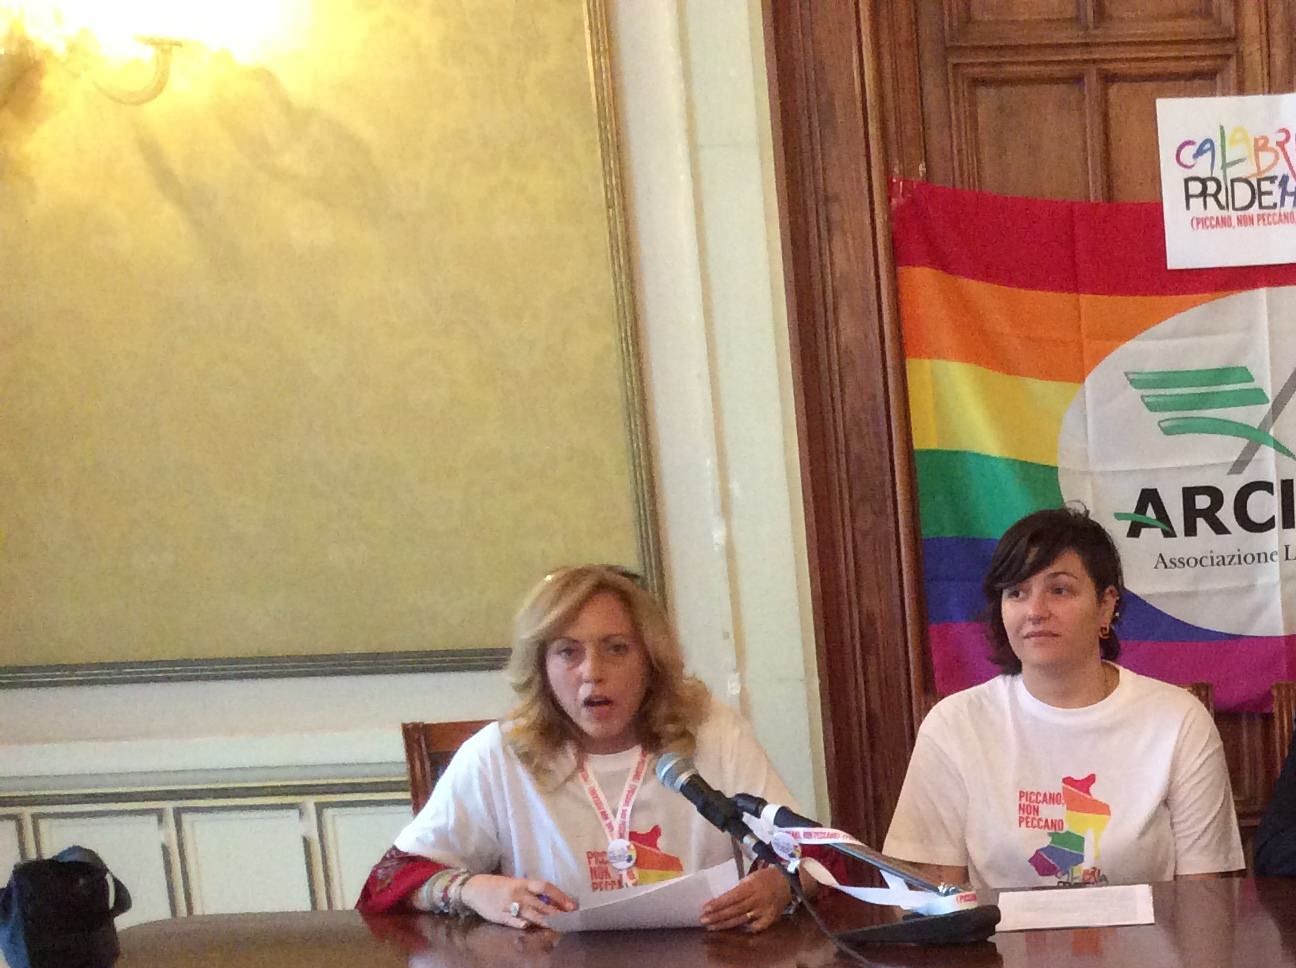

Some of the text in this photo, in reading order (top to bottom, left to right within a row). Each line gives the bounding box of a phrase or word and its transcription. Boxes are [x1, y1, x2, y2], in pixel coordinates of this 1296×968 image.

[1236, 213, 1255, 229] NON
[1153, 547, 1279, 571] Associazione
[1018, 803, 1039, 816] NON
[1018, 816, 1064, 831] PECCANO
